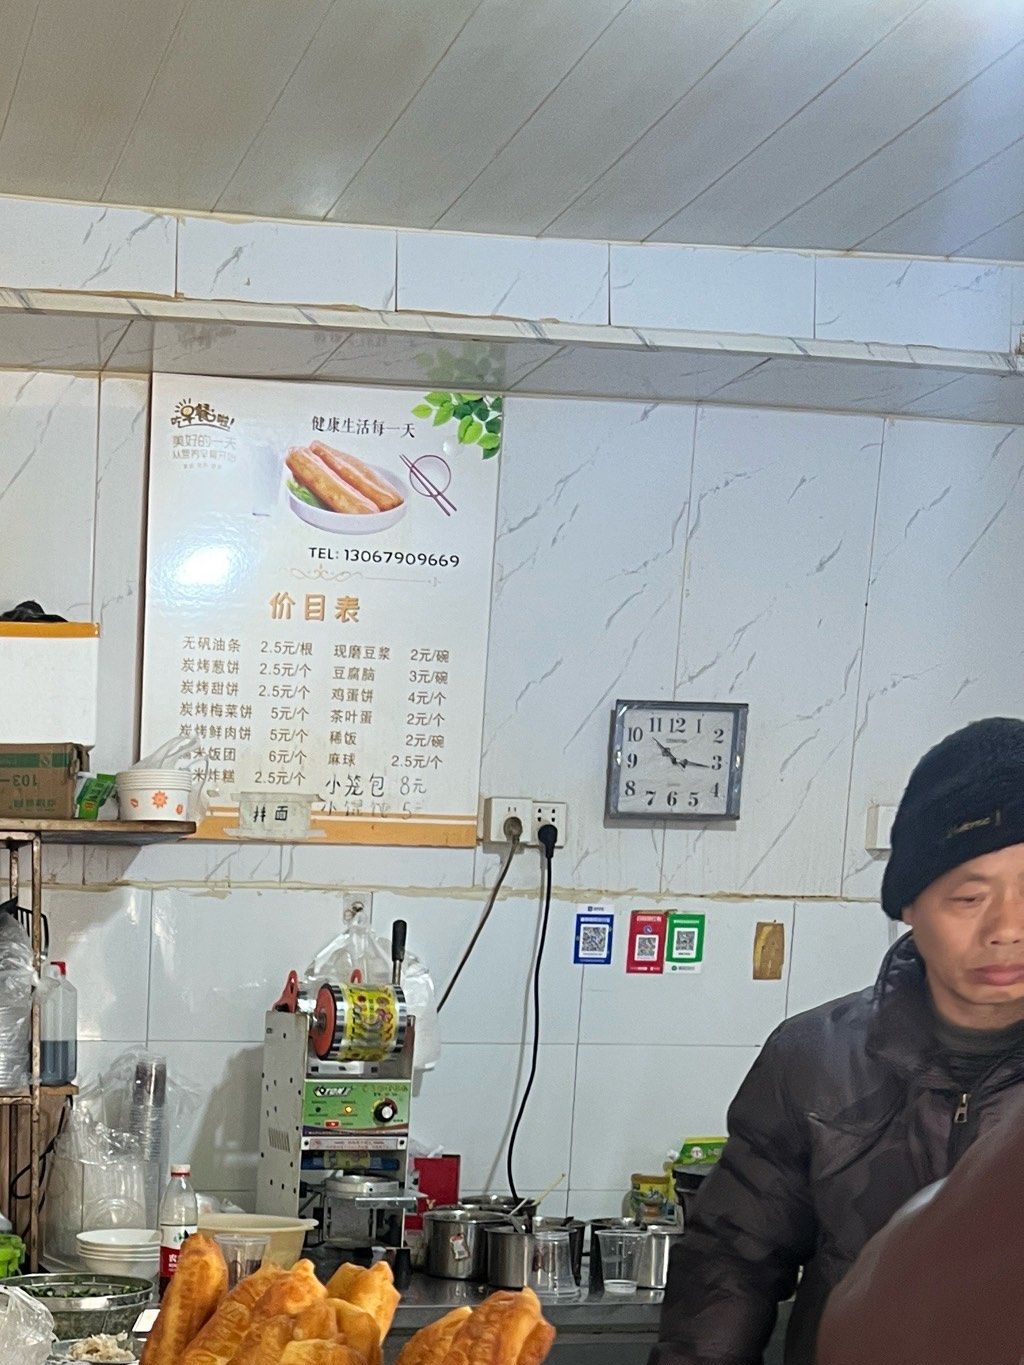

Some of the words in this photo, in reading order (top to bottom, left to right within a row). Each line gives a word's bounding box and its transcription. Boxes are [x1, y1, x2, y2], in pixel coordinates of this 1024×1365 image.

[311, 415, 415, 438] 健康生活每一天
[308, 547, 339, 560] TEL:
[344, 549, 460, 568] 13067909669
[268, 591, 361, 623] 价目表
[182, 636, 241, 653] 无矾油条
[260, 640, 313, 656] 2.5元/根
[333, 644, 391, 661] 现磨豆浆
[410, 648, 449, 663] 2元/碗
[181, 658, 240, 675] 炭烤葱饼
[259, 662, 312, 678] 2.5元/个
[332, 666, 375, 681] 豆腐脑
[409, 670, 448, 684] 3元/碗
[180, 680, 239, 696] 炭烤甜饼
[258, 684, 310, 700] 2.5元/个
[331, 688, 374, 703] 鸡蛋饼
[408, 691, 447, 706] 4元/个
[179, 702, 253, 719] 炭烤梅菜饼
[270, 706, 309, 721] 5元/个
[330, 709, 372, 724] 茶叶蛋
[406, 712, 445, 727] 2元/个
[627, 726, 644, 742] 10
[649, 717, 662, 733] 11
[669, 717, 686, 733] 12
[696, 718, 702, 734] 1
[269, 729, 309, 743] 5元/个
[329, 730, 357, 746] 稀饭
[405, 733, 445, 748] 2元/碗
[713, 728, 724, 744] 2
[268, 750, 307, 765] 6元/个
[328, 752, 356, 767] 麻球
[391, 754, 443, 770] 2.5元/个
[627, 753, 638, 769] 9
[711, 755, 722, 770] 3
[179, 767, 235, 784] 米炸糕
[254, 770, 306, 786] 2.5元/个
[325, 773, 385, 798] 小笼包
[624, 780, 636, 796] 8
[710, 782, 719, 798] 4
[645, 790, 657, 806] 7
[666, 791, 677, 807] 6
[688, 792, 700, 807] 5
